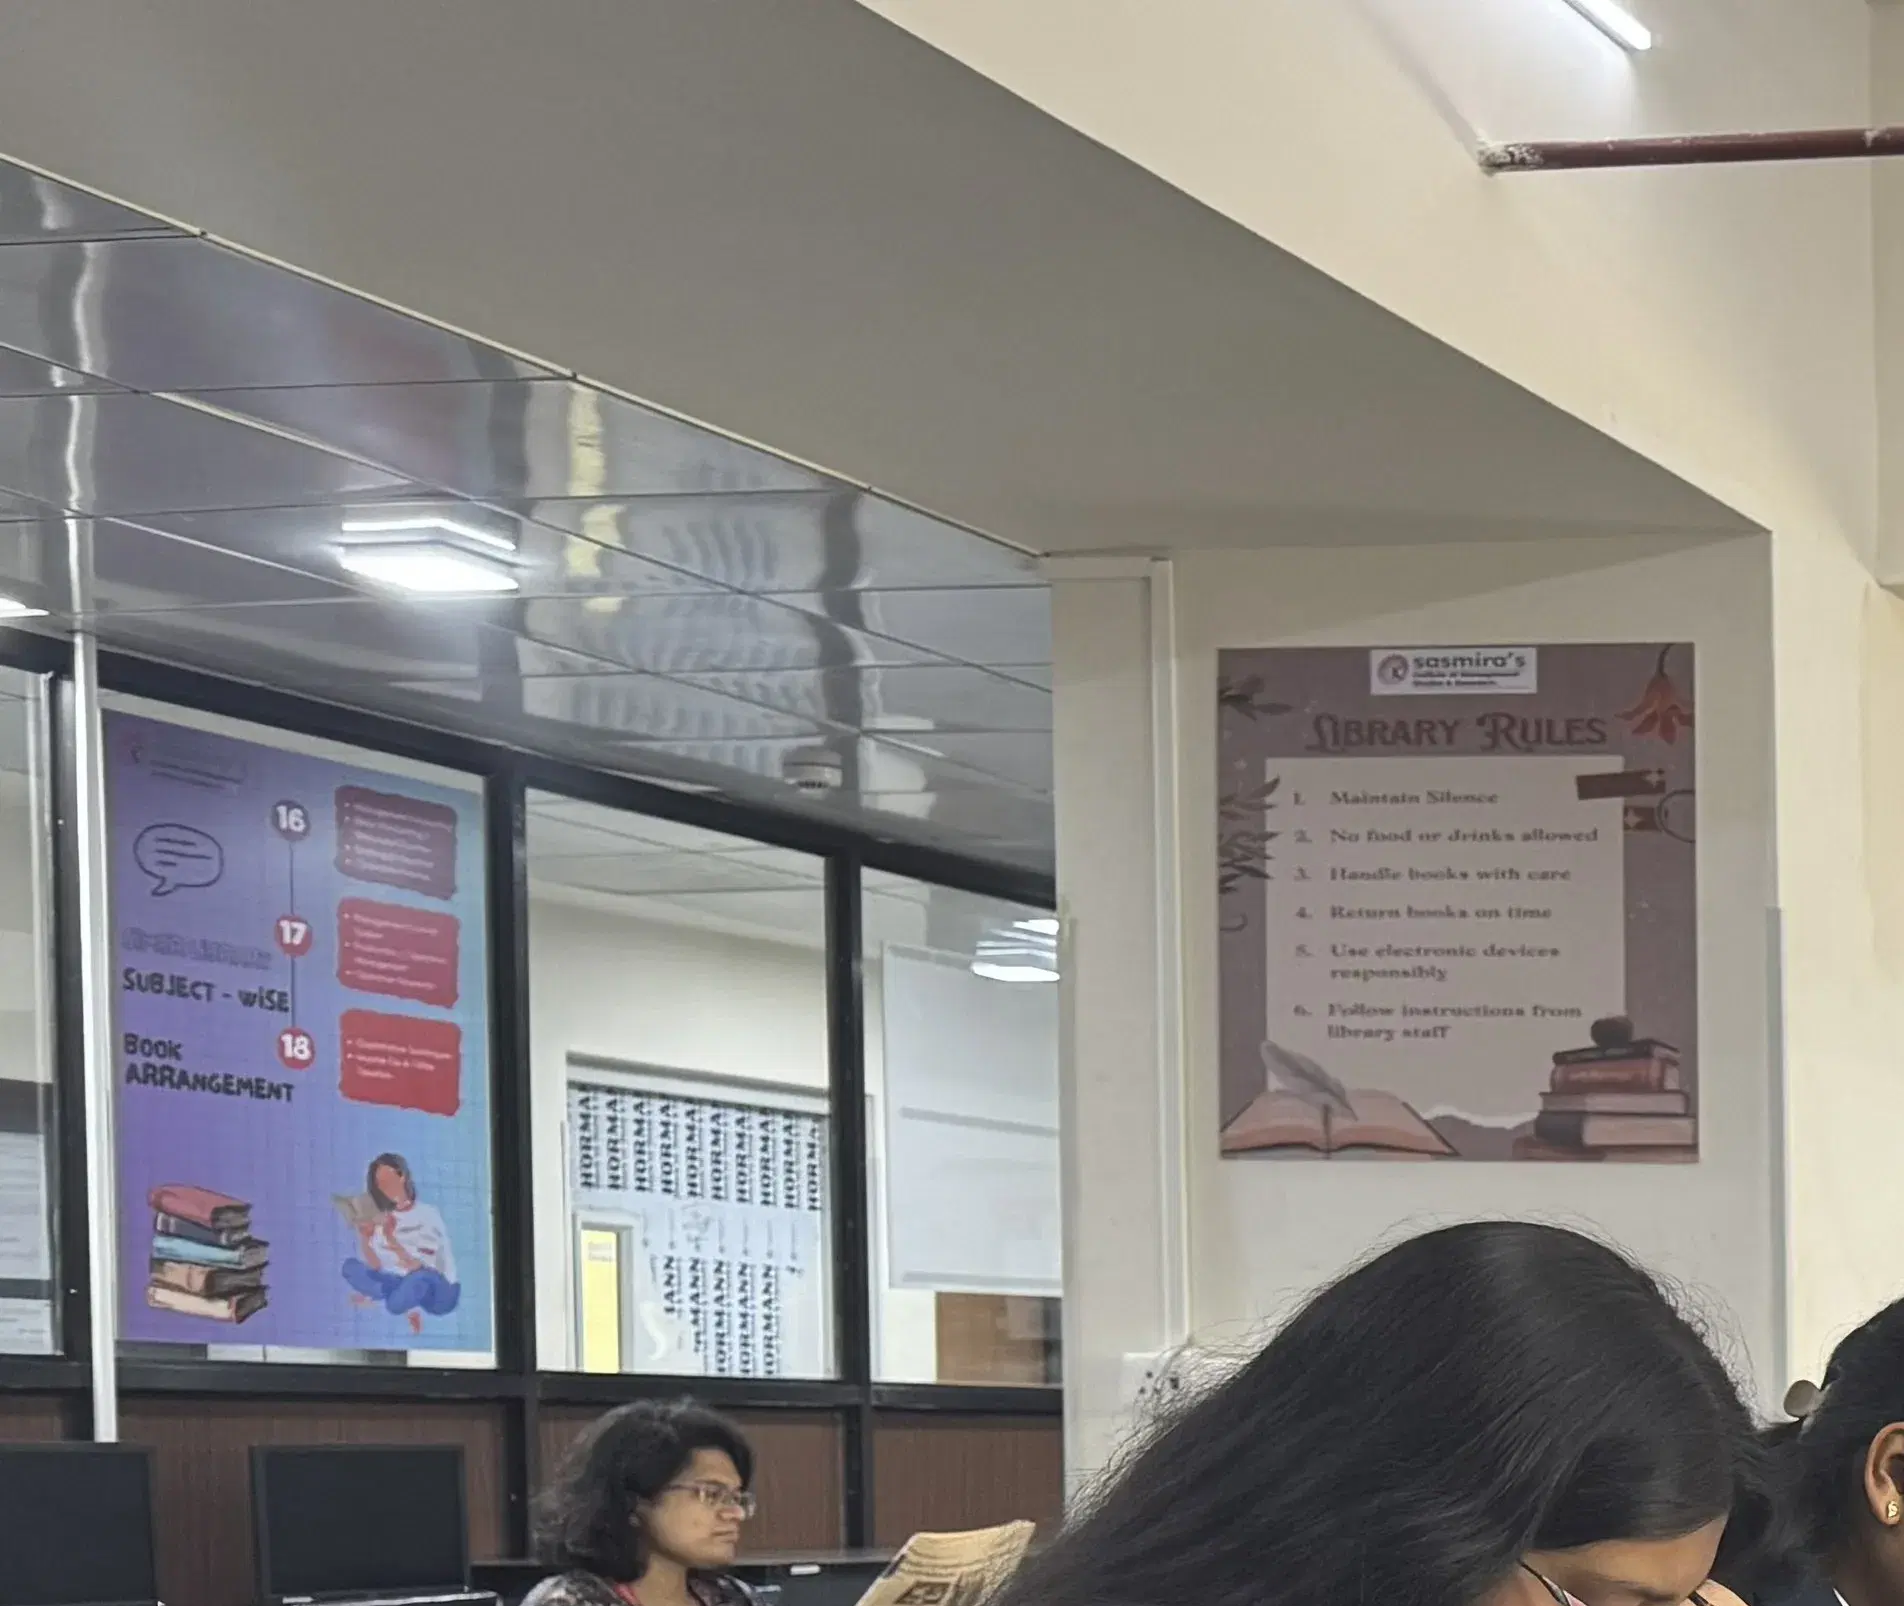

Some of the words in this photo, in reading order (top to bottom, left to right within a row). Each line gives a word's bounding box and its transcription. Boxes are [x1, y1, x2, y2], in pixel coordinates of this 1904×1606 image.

[1413, 651, 1527, 669] sasmira's
[1305, 712, 1462, 752] LIBRARY
[1475, 711, 1609, 752] RULES
[1329, 790, 1421, 804] Maintain
[1425, 789, 1501, 803] Silence
[276, 804, 307, 833] 16
[1329, 828, 1360, 843] No
[1366, 828, 1413, 842] food
[1447, 828, 1516, 843] drinks
[1520, 828, 1600, 843] allowed
[1330, 866, 1402, 881] Handle
[1408, 866, 1471, 881] books
[1476, 866, 1522, 881] with
[1526, 868, 1573, 881] care
[1330, 905, 1402, 920] Return
[279, 920, 308, 945] 17
[1330, 945, 1370, 958] Use
[1374, 943, 1478, 958] electronic
[1481, 943, 1561, 958] devices
[122, 967, 217, 1002] SUBJECT
[1329, 965, 1449, 982] responsibly
[1328, 1003, 1396, 1018] Follow
[1402, 1003, 1526, 1018] instructions
[1531, 1003, 1583, 1018] from
[281, 1034, 311, 1060] 18
[1327, 1023, 1395, 1041] library
[1401, 1024, 1451, 1039] staff
[125, 1062, 295, 1103] ARRANGEMENT
[579, 1088, 593, 1188] HORMA
[606, 1091, 620, 1190] HORMA
[633, 1094, 647, 1193] HORMA
[660, 1096, 673, 1195] HORMA
[685, 1101, 698, 1197] HORMA
[711, 1105, 723, 1200] HORMA
[736, 1109, 748, 1203] HORMA
[760, 1113, 772, 1206] HORMA
[784, 1117, 795, 1209] HORMA
